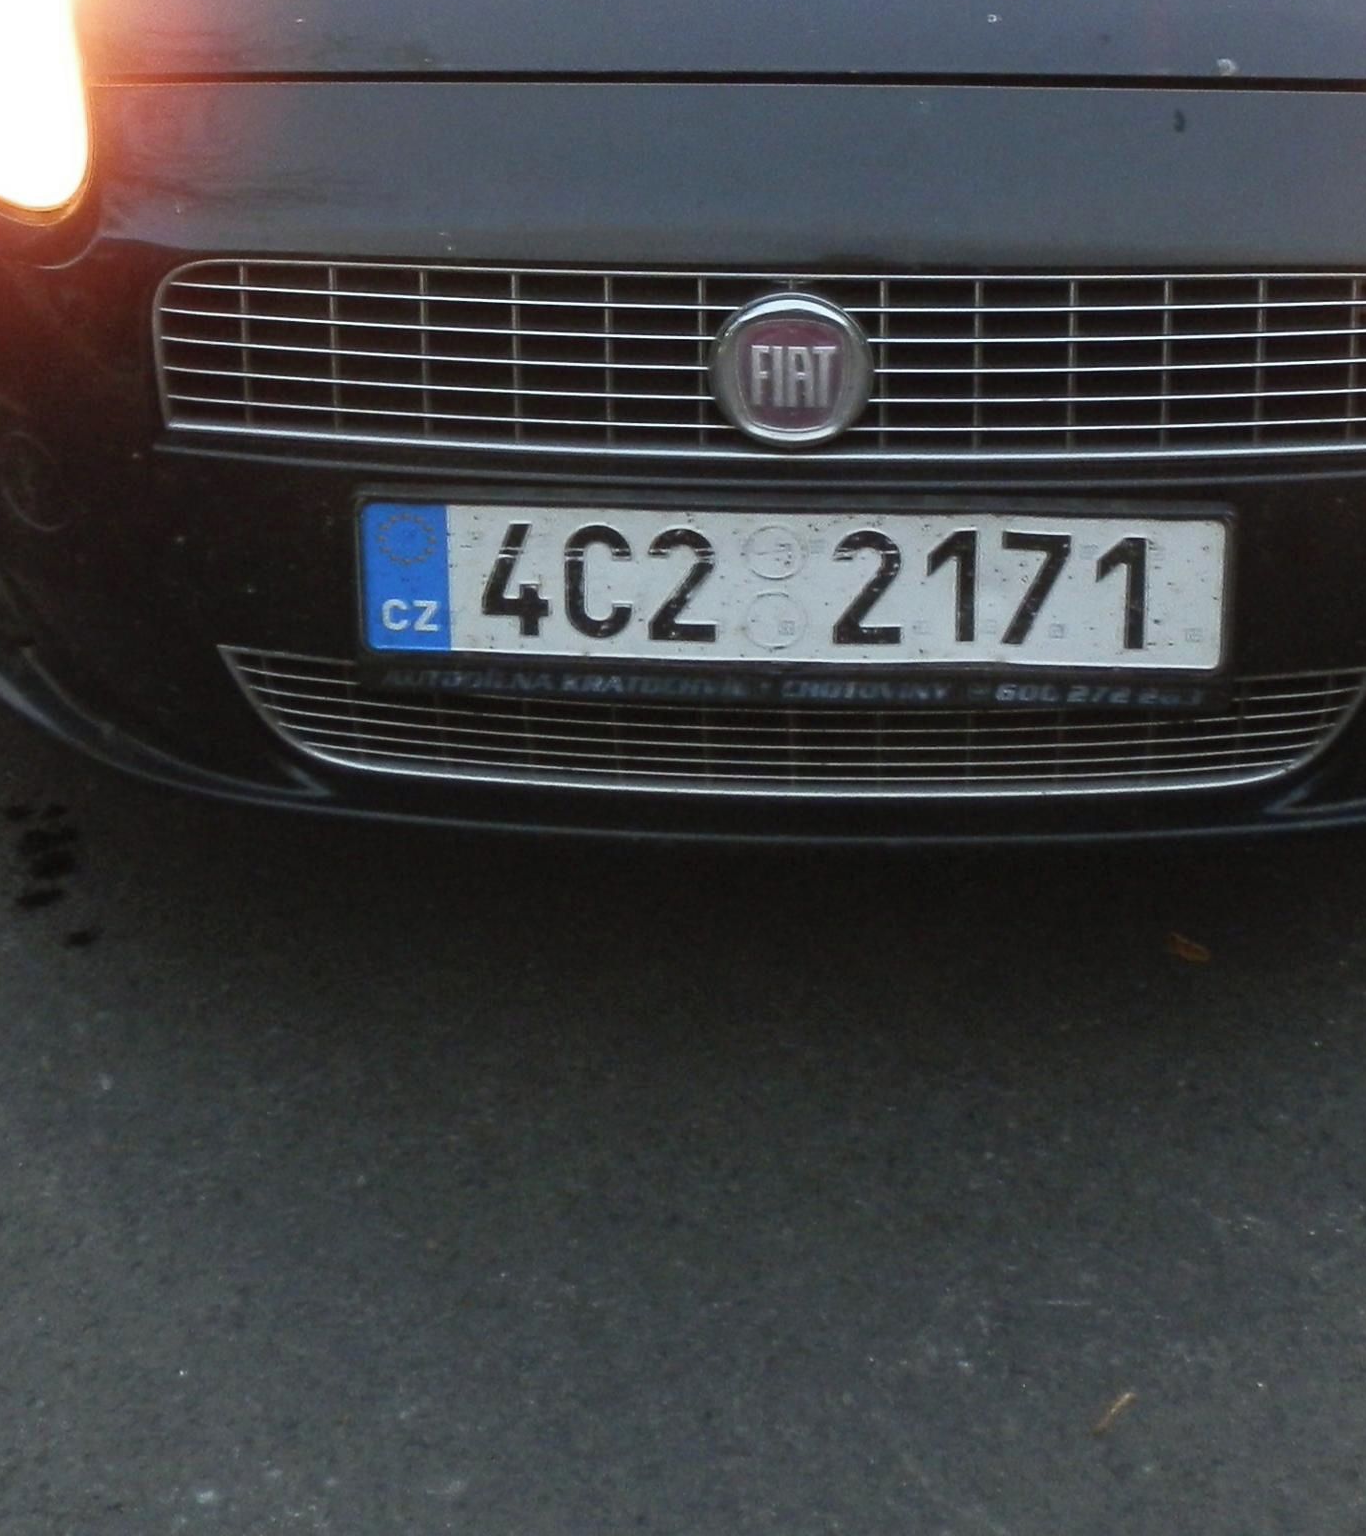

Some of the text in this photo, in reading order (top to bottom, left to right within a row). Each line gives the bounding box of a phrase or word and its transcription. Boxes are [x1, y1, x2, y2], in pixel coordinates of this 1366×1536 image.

[751, 345, 838, 407] FIAT
[382, 521, 1149, 651] CZ 4C2 2171
